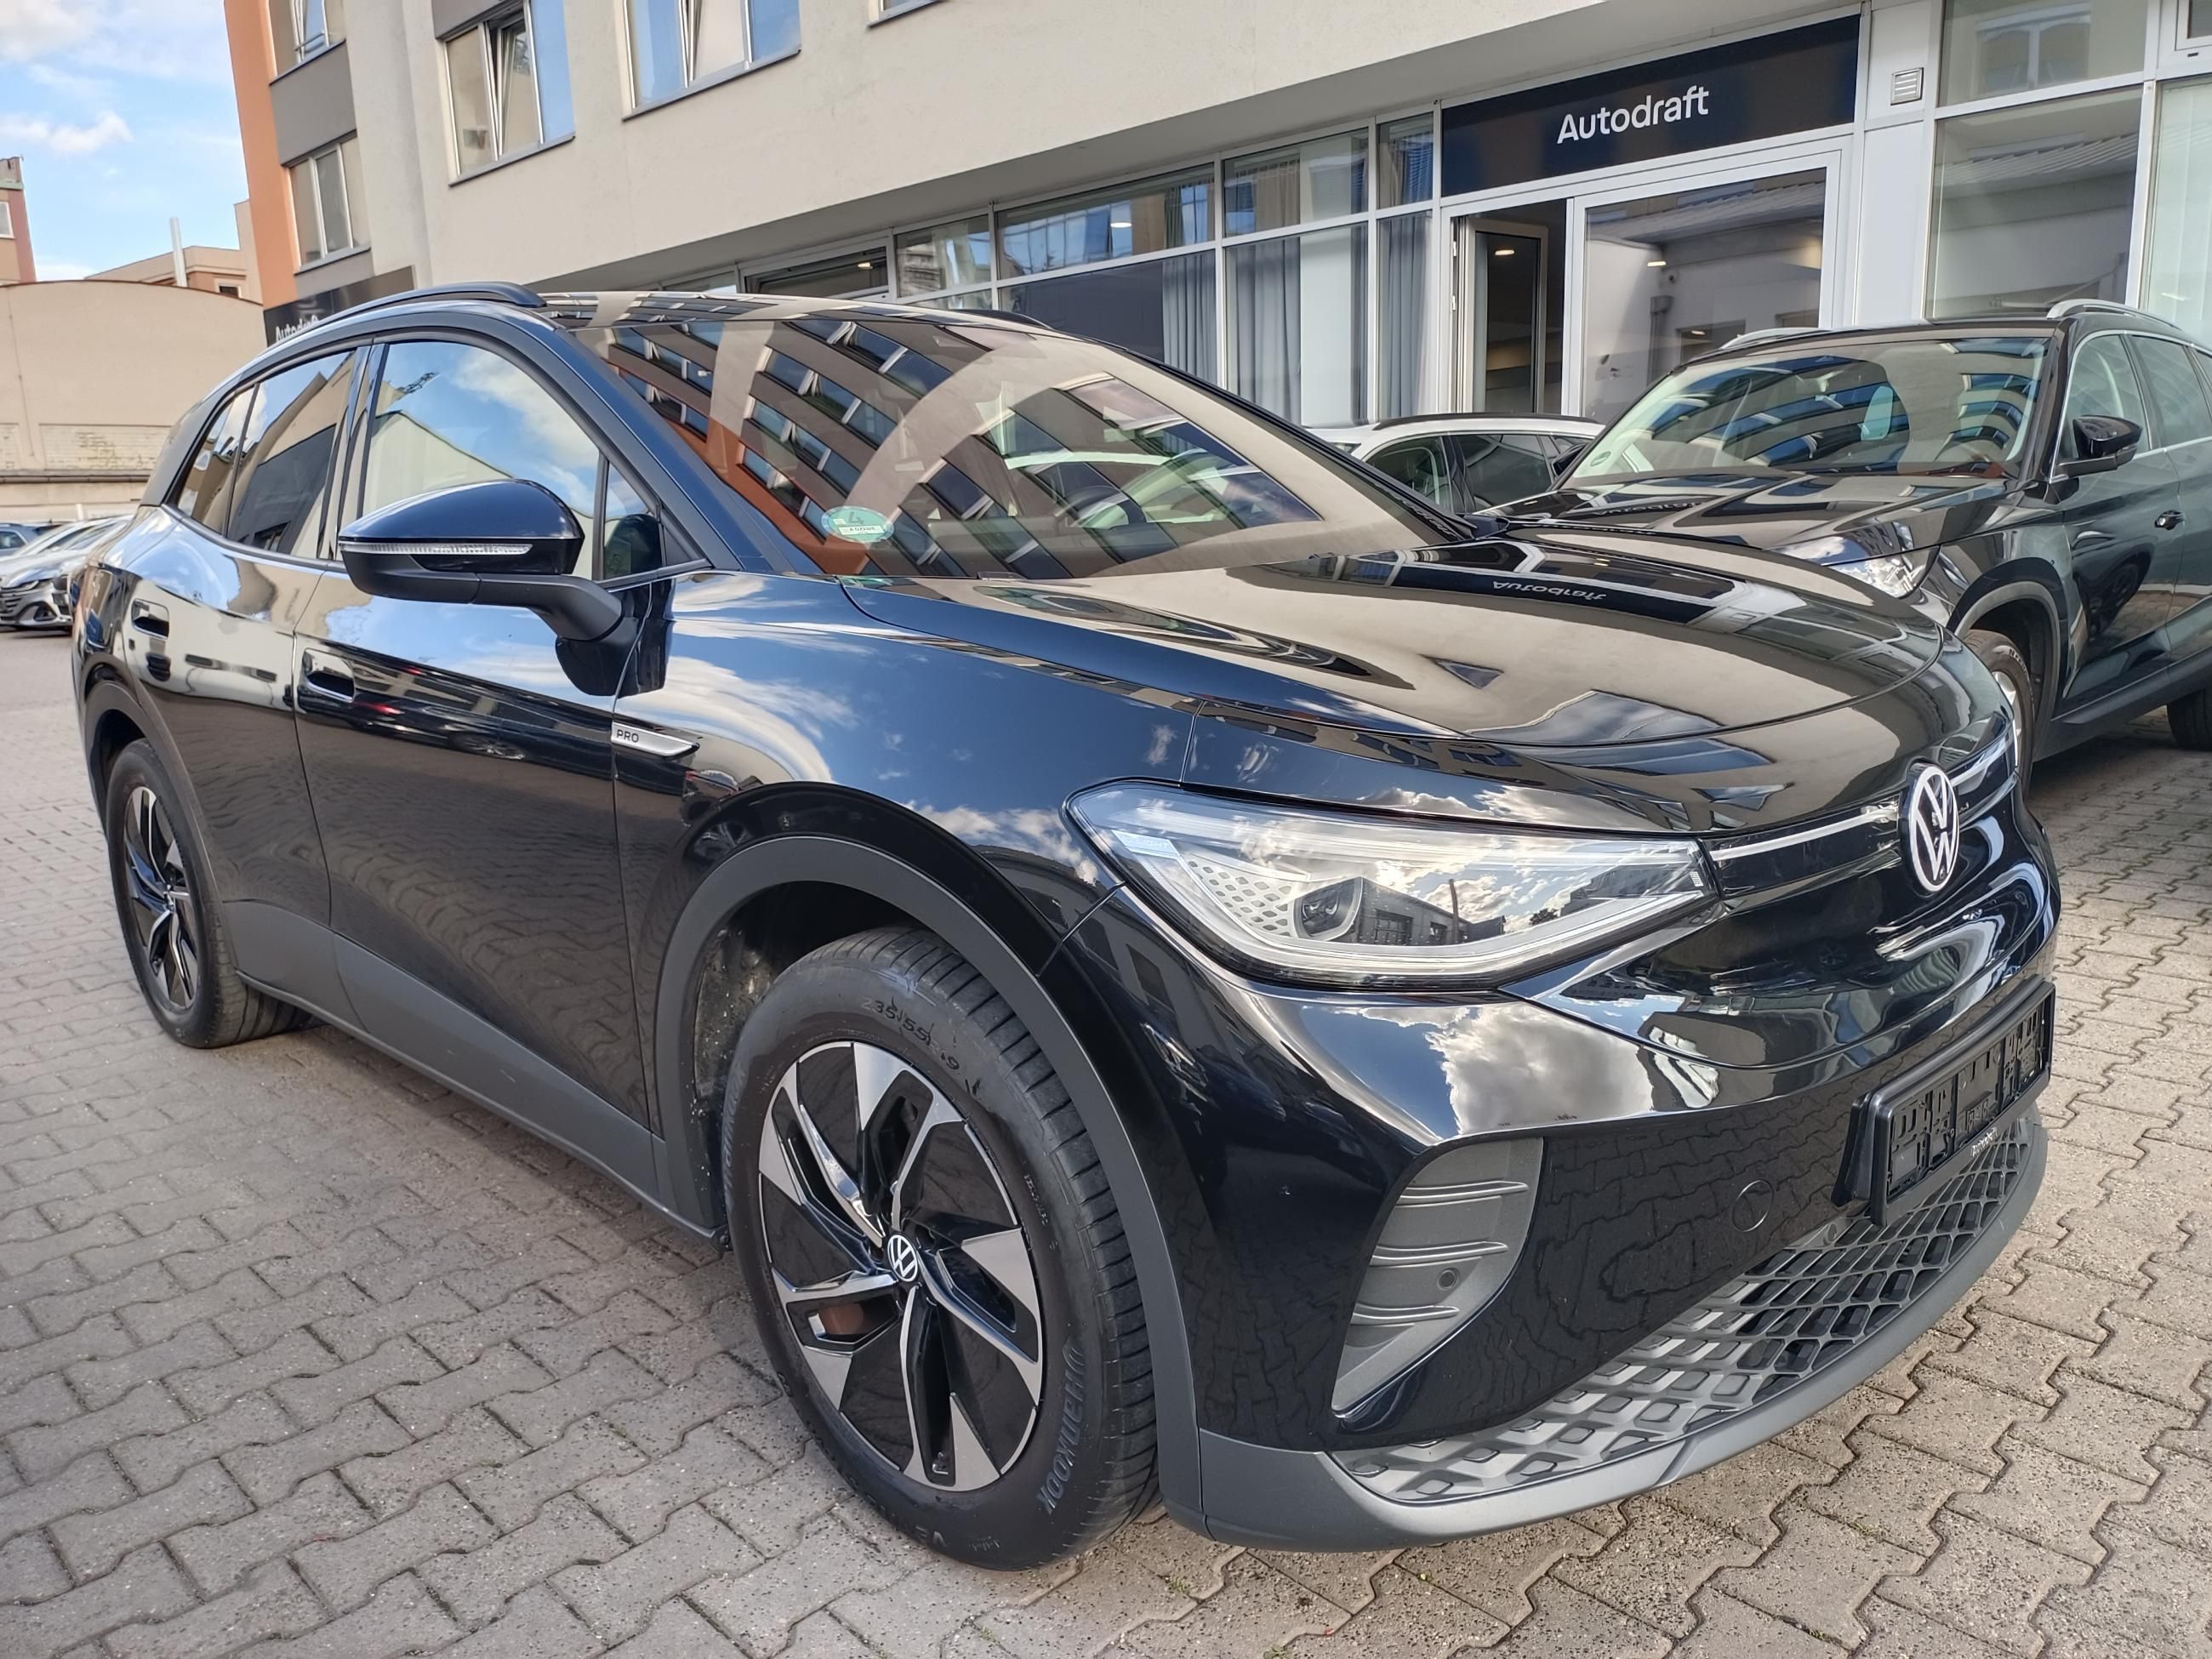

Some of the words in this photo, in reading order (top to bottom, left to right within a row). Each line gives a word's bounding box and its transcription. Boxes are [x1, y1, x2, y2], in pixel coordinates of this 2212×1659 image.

[1556, 85, 1709, 145] Autodraft
[616, 729, 639, 743] PRO
[1035, 1368, 1085, 1515] Hankook
